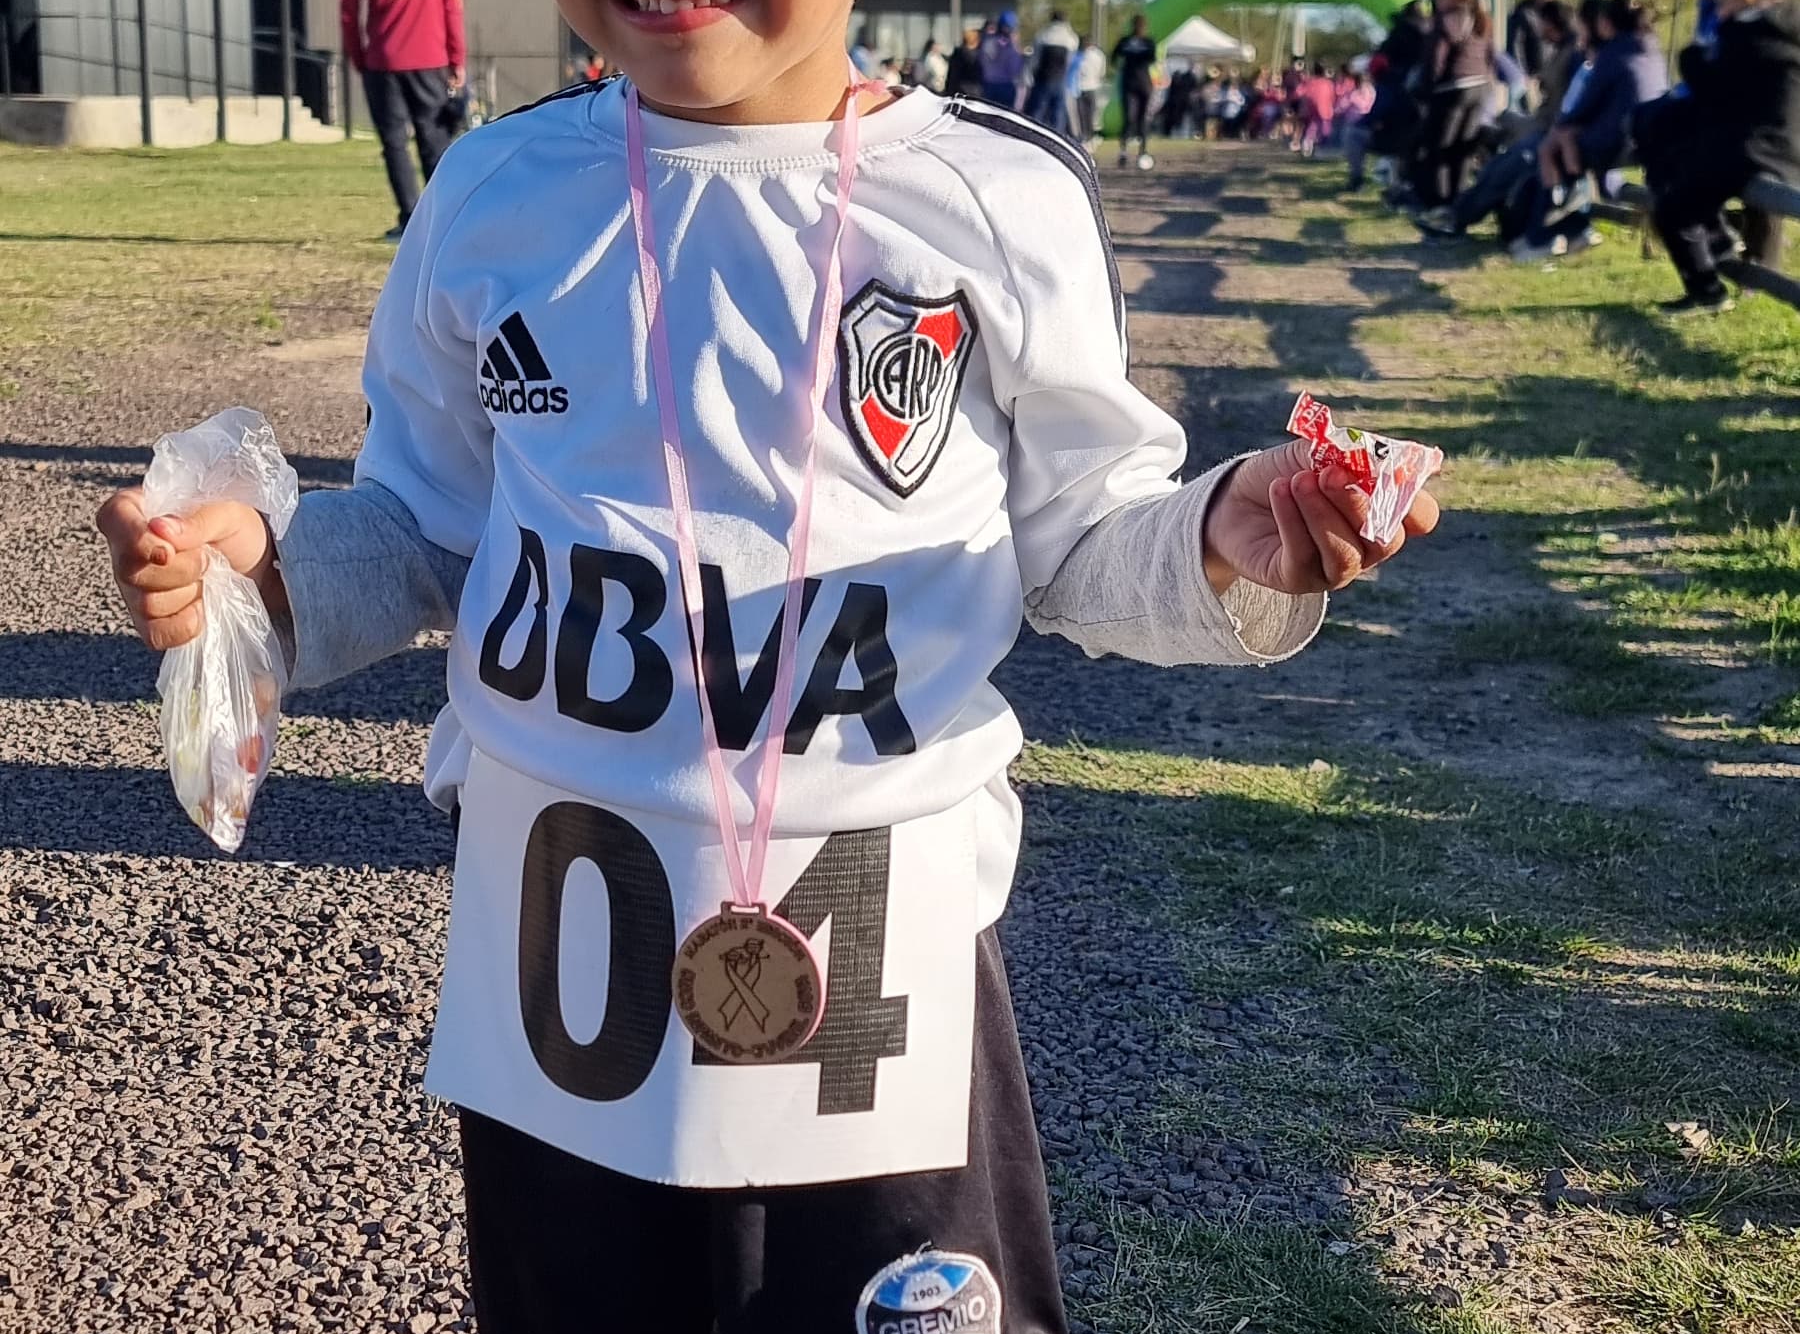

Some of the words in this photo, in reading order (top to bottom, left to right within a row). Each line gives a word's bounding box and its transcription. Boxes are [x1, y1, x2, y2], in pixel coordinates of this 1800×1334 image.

[480, 379, 569, 415] adidas
[479, 525, 916, 756] BBVA
[518, 799, 910, 1116] 04
[911, 1285, 942, 1302] 1903
